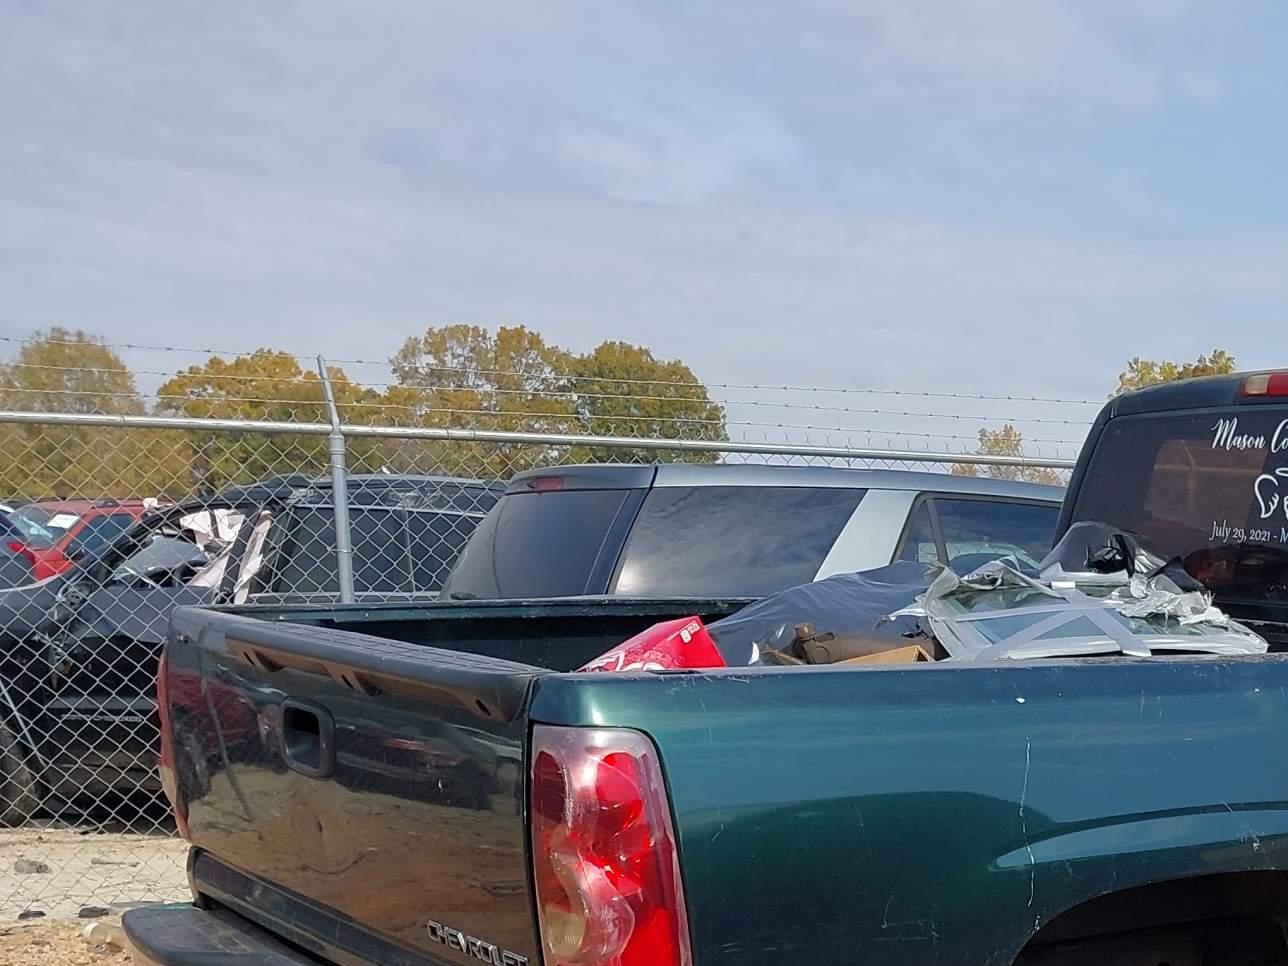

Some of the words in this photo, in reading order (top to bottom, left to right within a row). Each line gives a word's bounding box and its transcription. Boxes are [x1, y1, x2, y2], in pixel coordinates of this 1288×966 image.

[1210, 416, 1267, 451] Mason
[1208, 519, 1232, 542] July
[1232, 527, 1247, 541] 29,
[1249, 529, 1271, 542] 2021
